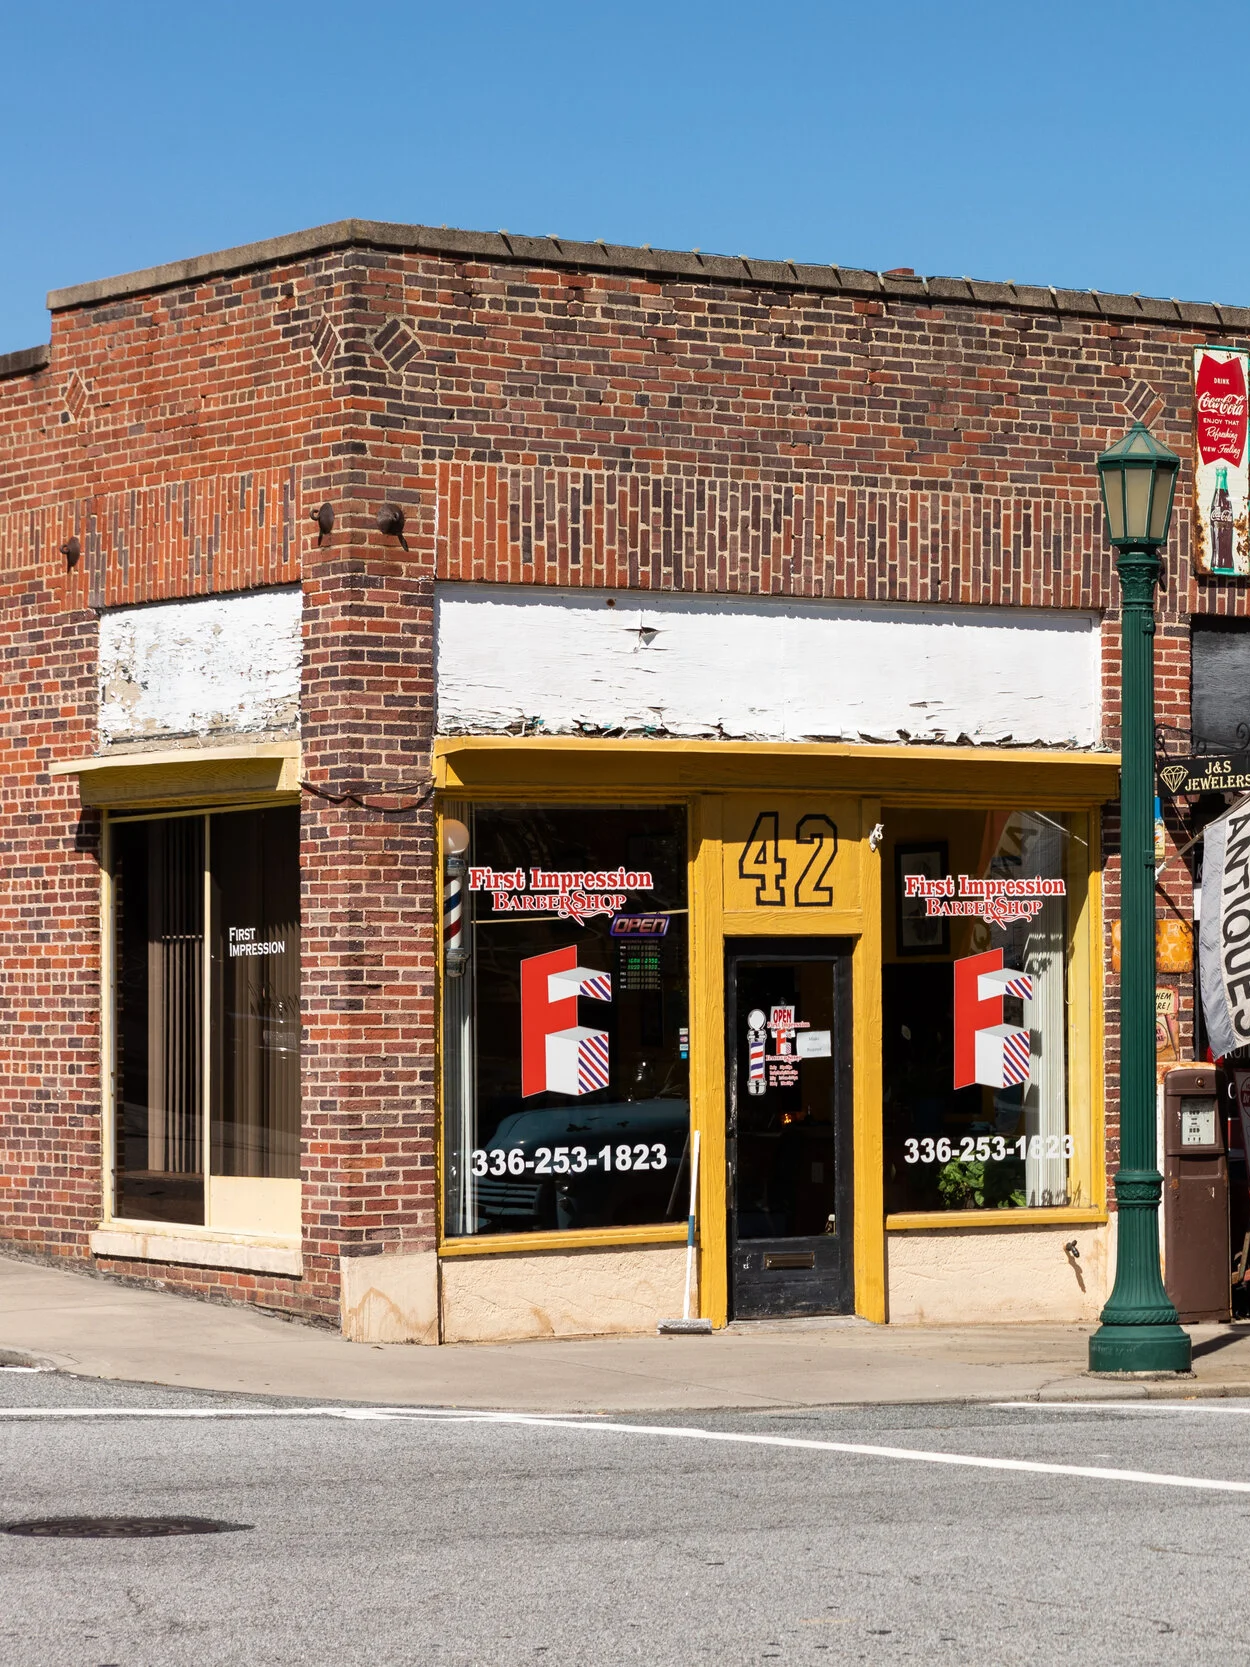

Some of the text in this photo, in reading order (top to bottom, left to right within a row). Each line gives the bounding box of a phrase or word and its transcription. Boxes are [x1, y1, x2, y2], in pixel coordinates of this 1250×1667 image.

[1213, 377, 1230, 385] DRINK
[1198, 391, 1246, 416] Coca-Cola
[1203, 417, 1223, 425] ENJOY
[1205, 426, 1238, 444] Refreshing
[1217, 443, 1241, 459] Feeling
[1204, 760, 1232, 775] J&S
[738, 811, 838, 907] 42
[468, 866, 654, 895] First Impression
[904, 874, 1067, 900] First Impression
[614, 918, 667, 933] OPEN
[1156, 992, 1172, 1000] HEM
[773, 1009, 792, 1024] OPEN
[904, 1135, 1075, 1163] 336-253-1823
[471, 1143, 668, 1176] 336-253-1823
